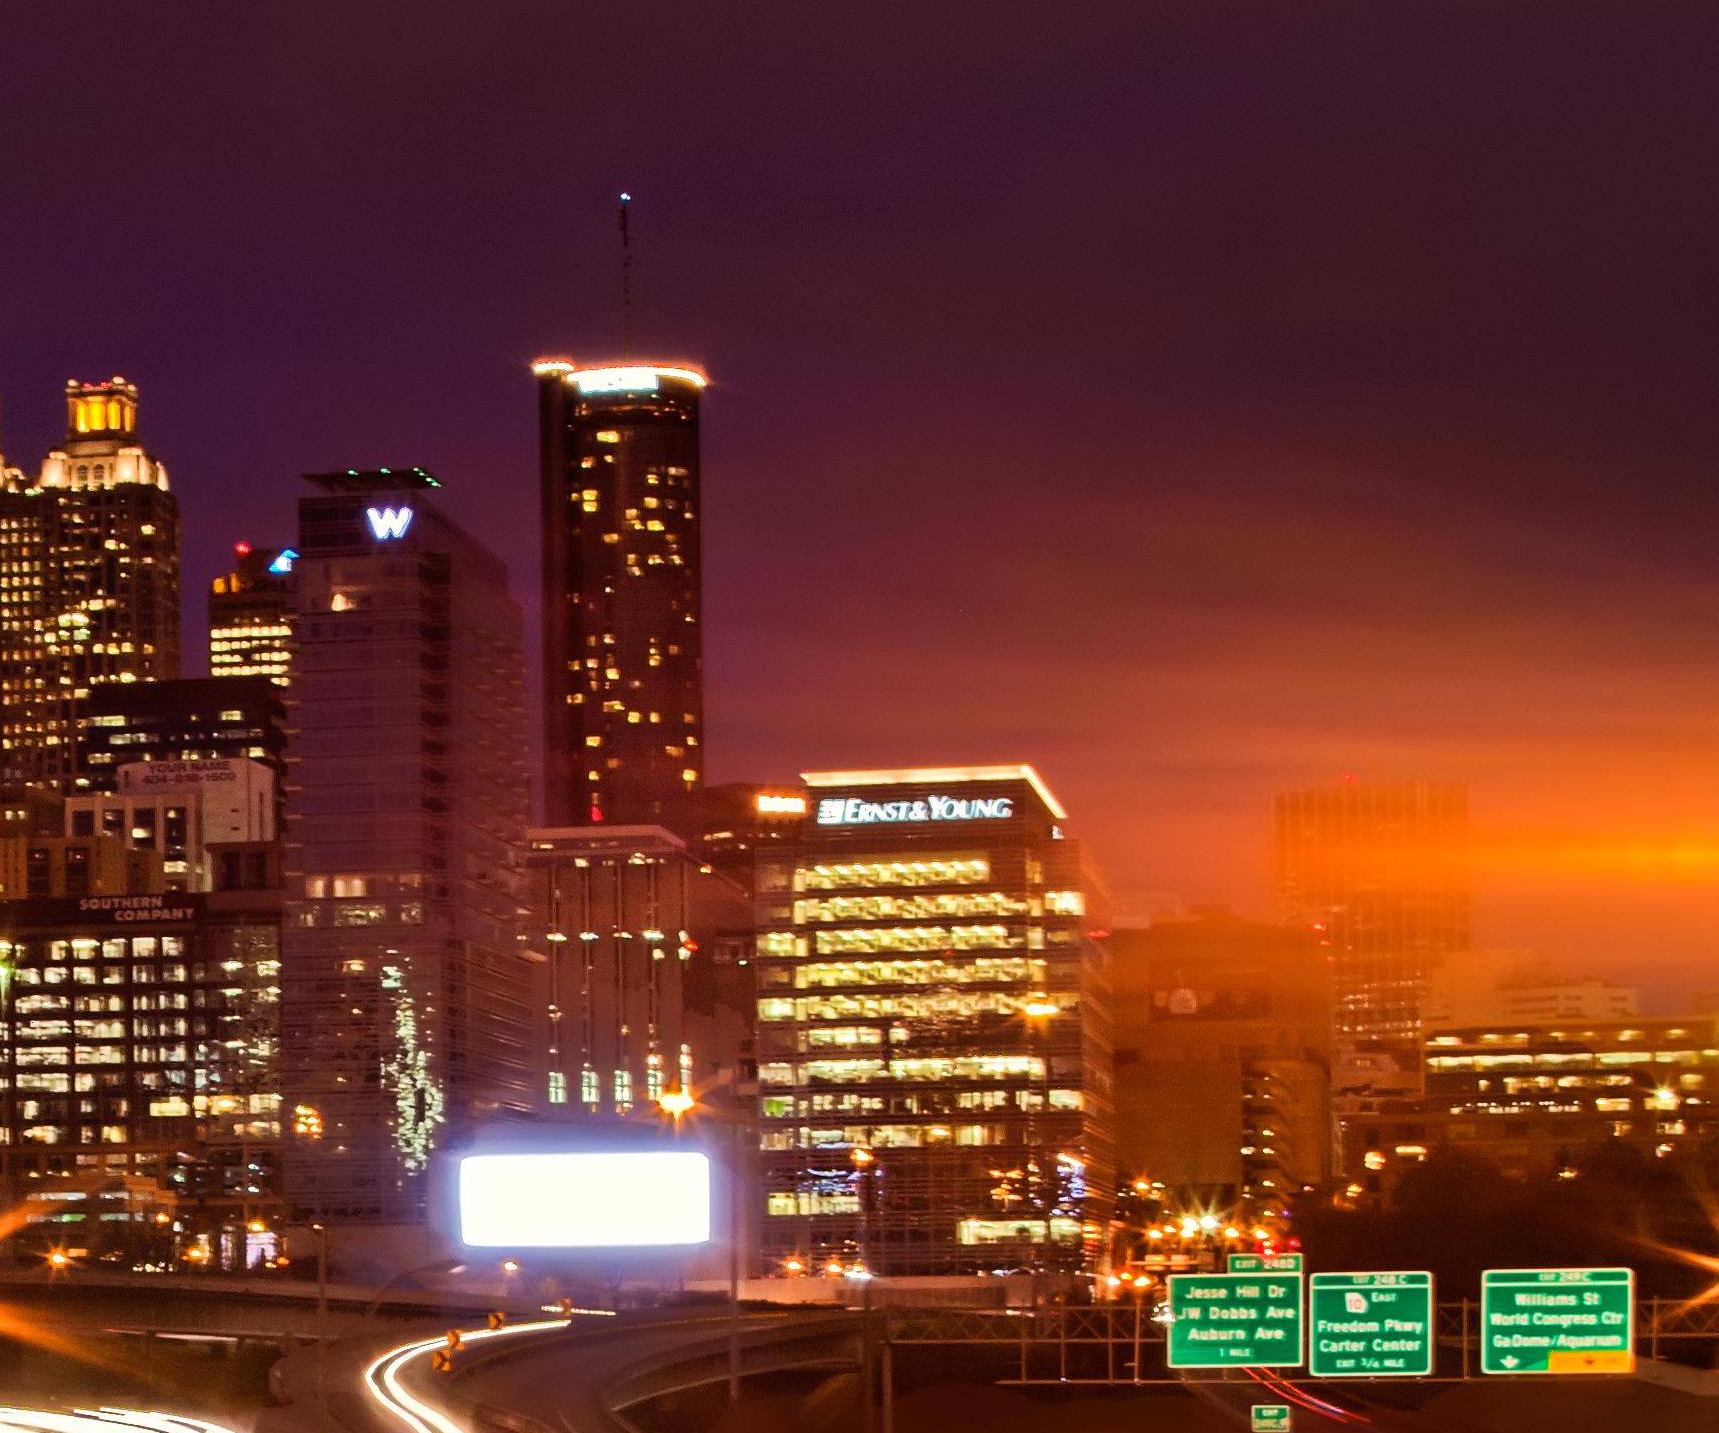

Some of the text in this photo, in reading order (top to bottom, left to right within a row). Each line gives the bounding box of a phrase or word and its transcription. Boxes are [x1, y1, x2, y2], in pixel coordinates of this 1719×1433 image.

[366, 506, 413, 540] W
[80, 896, 163, 910] SOUTHERN
[115, 907, 194, 921] COMPANY
[1185, 1284, 1287, 1299] Jesse Hill Dr
[1514, 1291, 1601, 1306] Williams St
[1176, 1306, 1296, 1320] JW Dobbs Ave
[1490, 1311, 1624, 1329] World Congress Ctr
[1318, 1318, 1423, 1335] Freedom Pkwy
[1187, 1327, 1285, 1341] Auburn Ave
[1229, 1348, 1251, 1357] MILE
[1319, 1338, 1421, 1353] Carter Center
[1383, 1358, 1405, 1368] MILE
